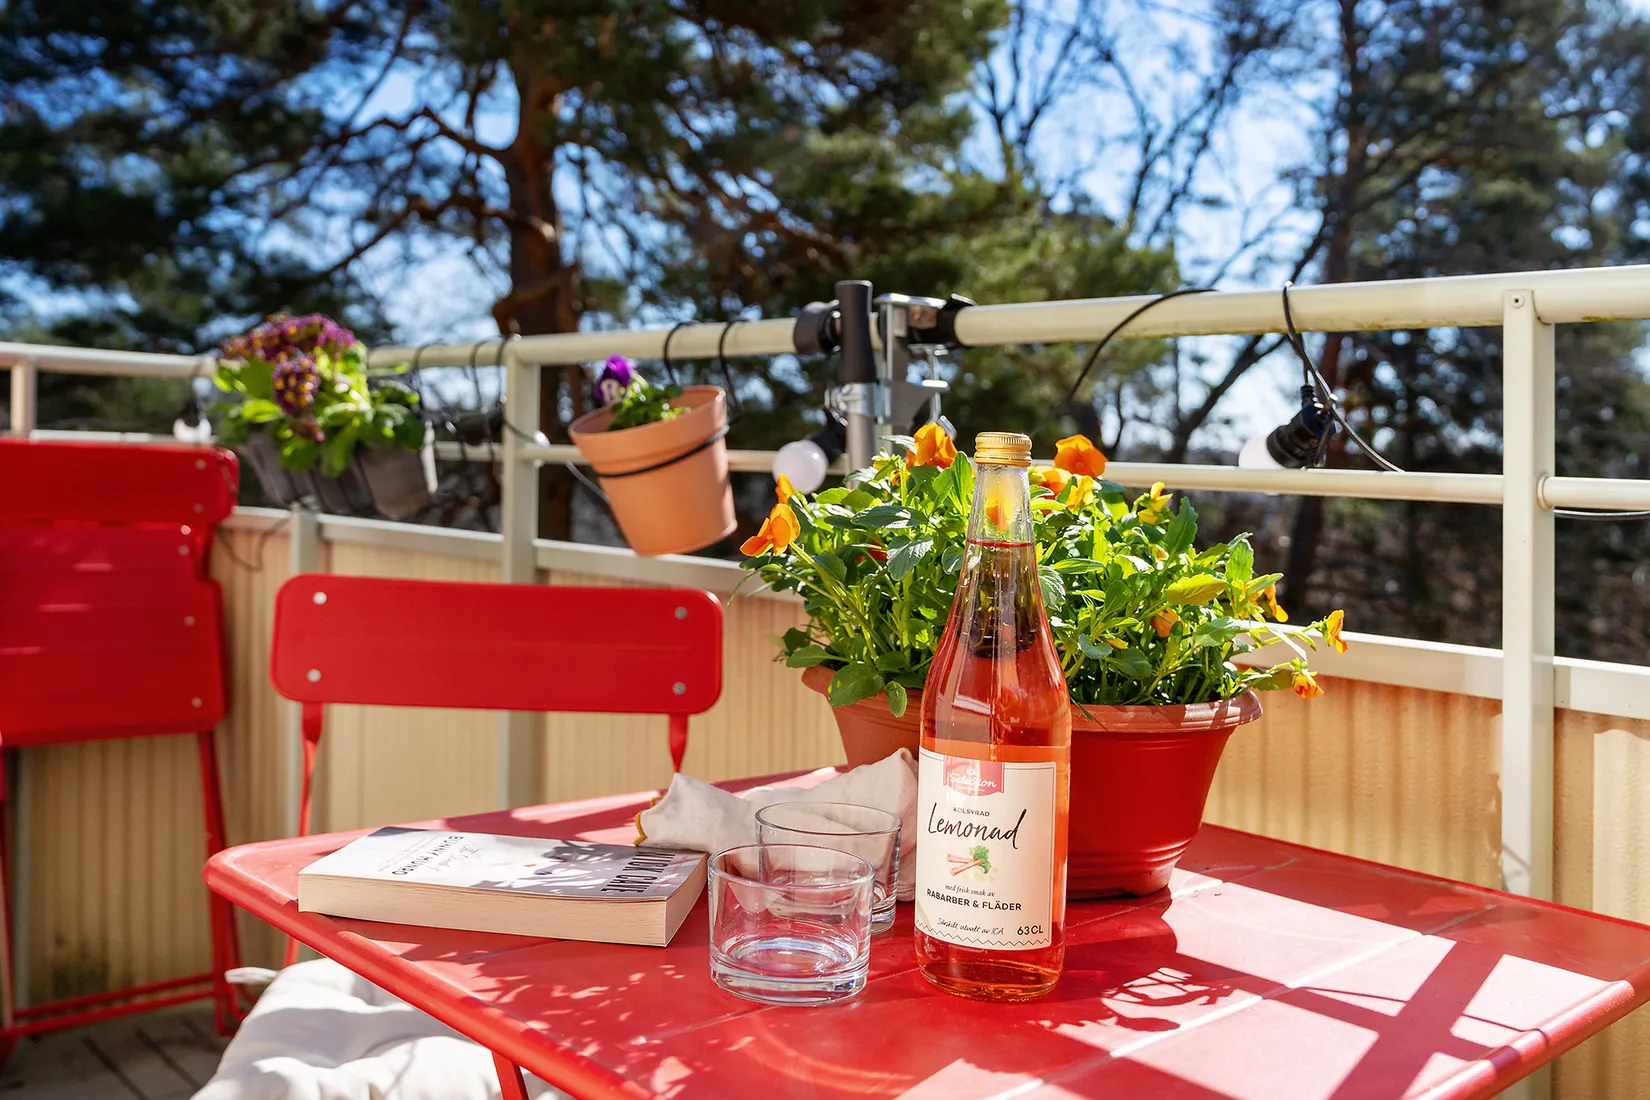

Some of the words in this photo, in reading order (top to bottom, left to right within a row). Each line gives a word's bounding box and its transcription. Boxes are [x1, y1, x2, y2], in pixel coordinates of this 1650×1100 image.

[949, 772, 997, 788] Selection
[952, 807, 990, 817] KOLSYRAD
[928, 802, 1027, 850] Lemonad
[426, 835, 464, 856] BUNNY
[392, 855, 432, 875] MUNRO
[600, 874, 658, 893] CAVE
[945, 884, 956, 892] med
[971, 889, 986, 897] smak
[926, 888, 970, 907] RABARBER
[972, 900, 980, 908] &
[982, 900, 1022, 911] FLÄDER
[991, 927, 1004, 936] ICA
